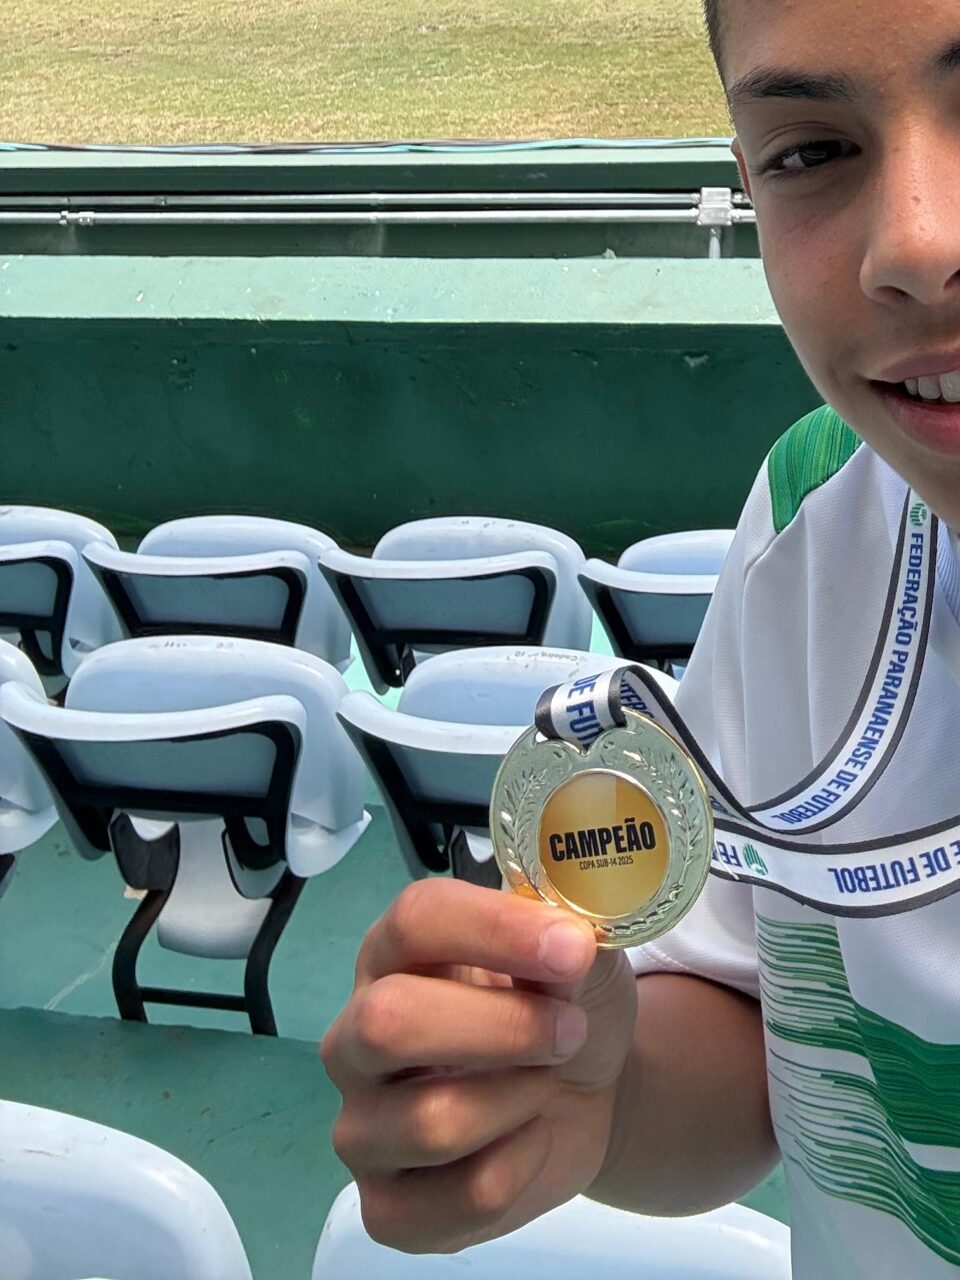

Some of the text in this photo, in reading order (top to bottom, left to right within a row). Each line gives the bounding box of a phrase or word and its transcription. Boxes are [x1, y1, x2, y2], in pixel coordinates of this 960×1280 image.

[772, 532, 924, 825] FEDERAÇÃO PARANAENSE DE FUTEBOL
[549, 817, 657, 862] CAMPEÃO
[579, 856, 634, 871] COPA SUB-14 2025
[828, 862, 921, 893] FUTEBOL
[922, 853, 951, 881] DE
